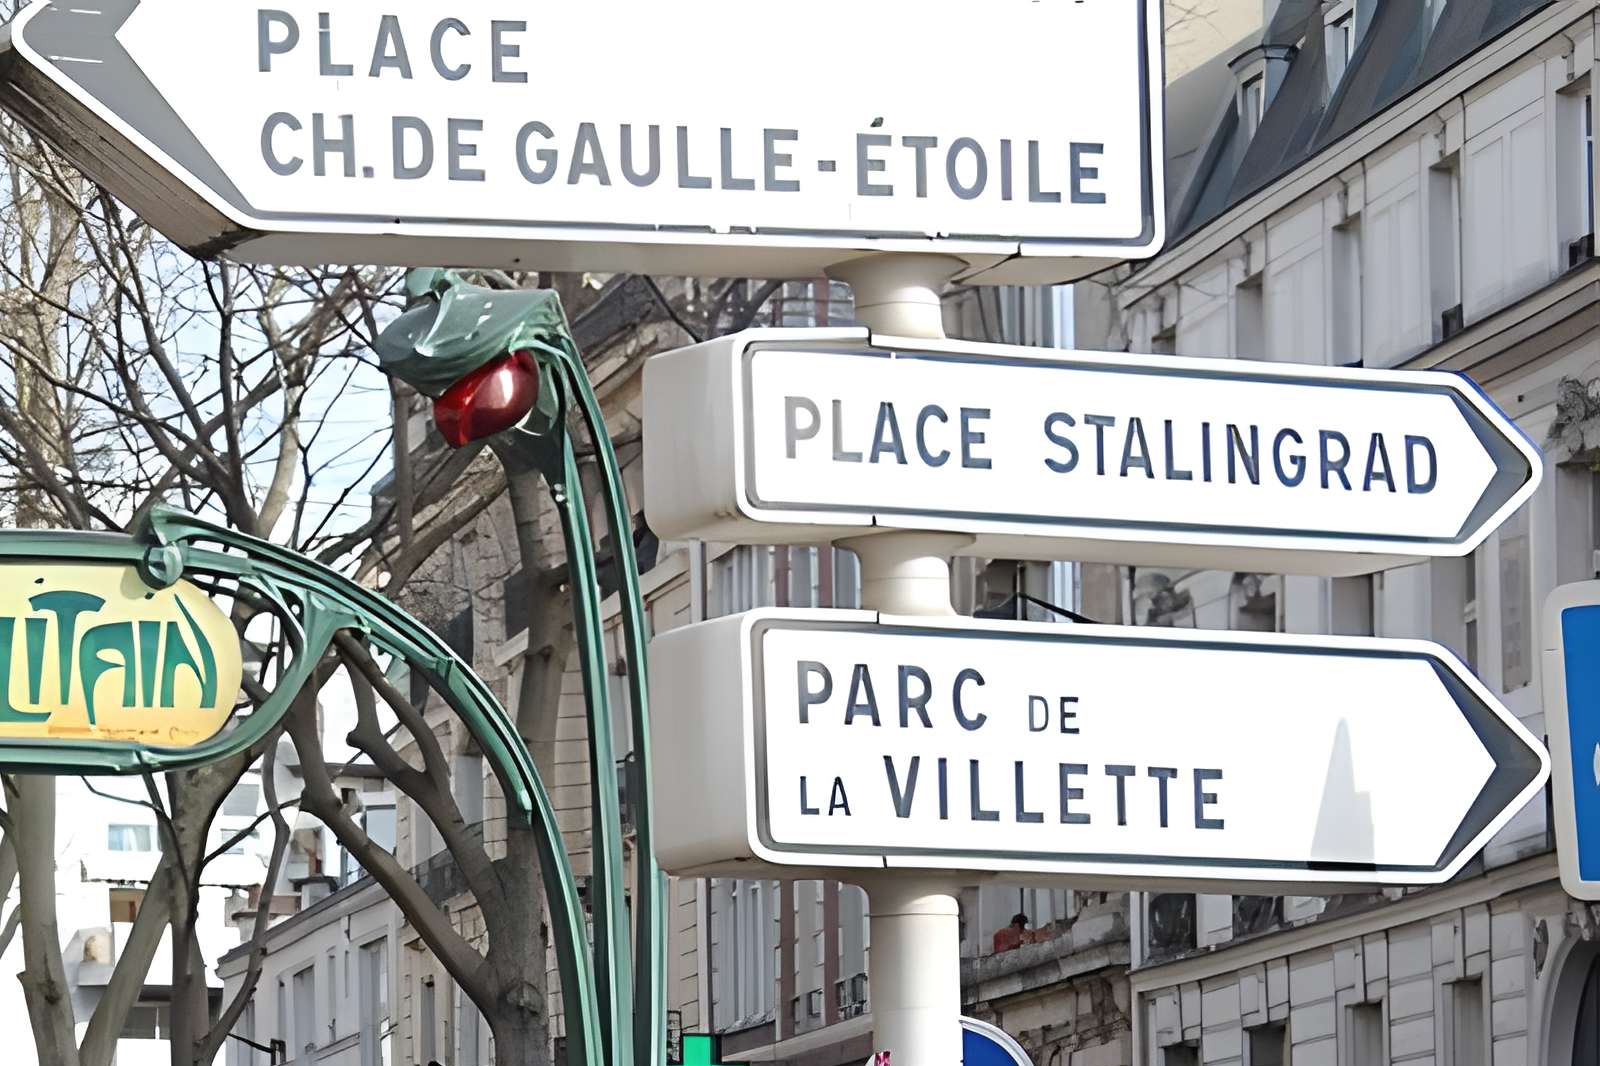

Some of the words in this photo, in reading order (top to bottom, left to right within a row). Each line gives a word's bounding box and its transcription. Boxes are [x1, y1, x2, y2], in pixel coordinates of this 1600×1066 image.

[258, 9, 528, 83] PLACE
[785, 396, 992, 469] PLACE
[1044, 412, 1437, 494] STALINGRAD
[797, 661, 987, 731] PARC
[1029, 695, 1080, 734] DE
[800, 776, 851, 816] LA
[883, 755, 1224, 830] VILLETTE
